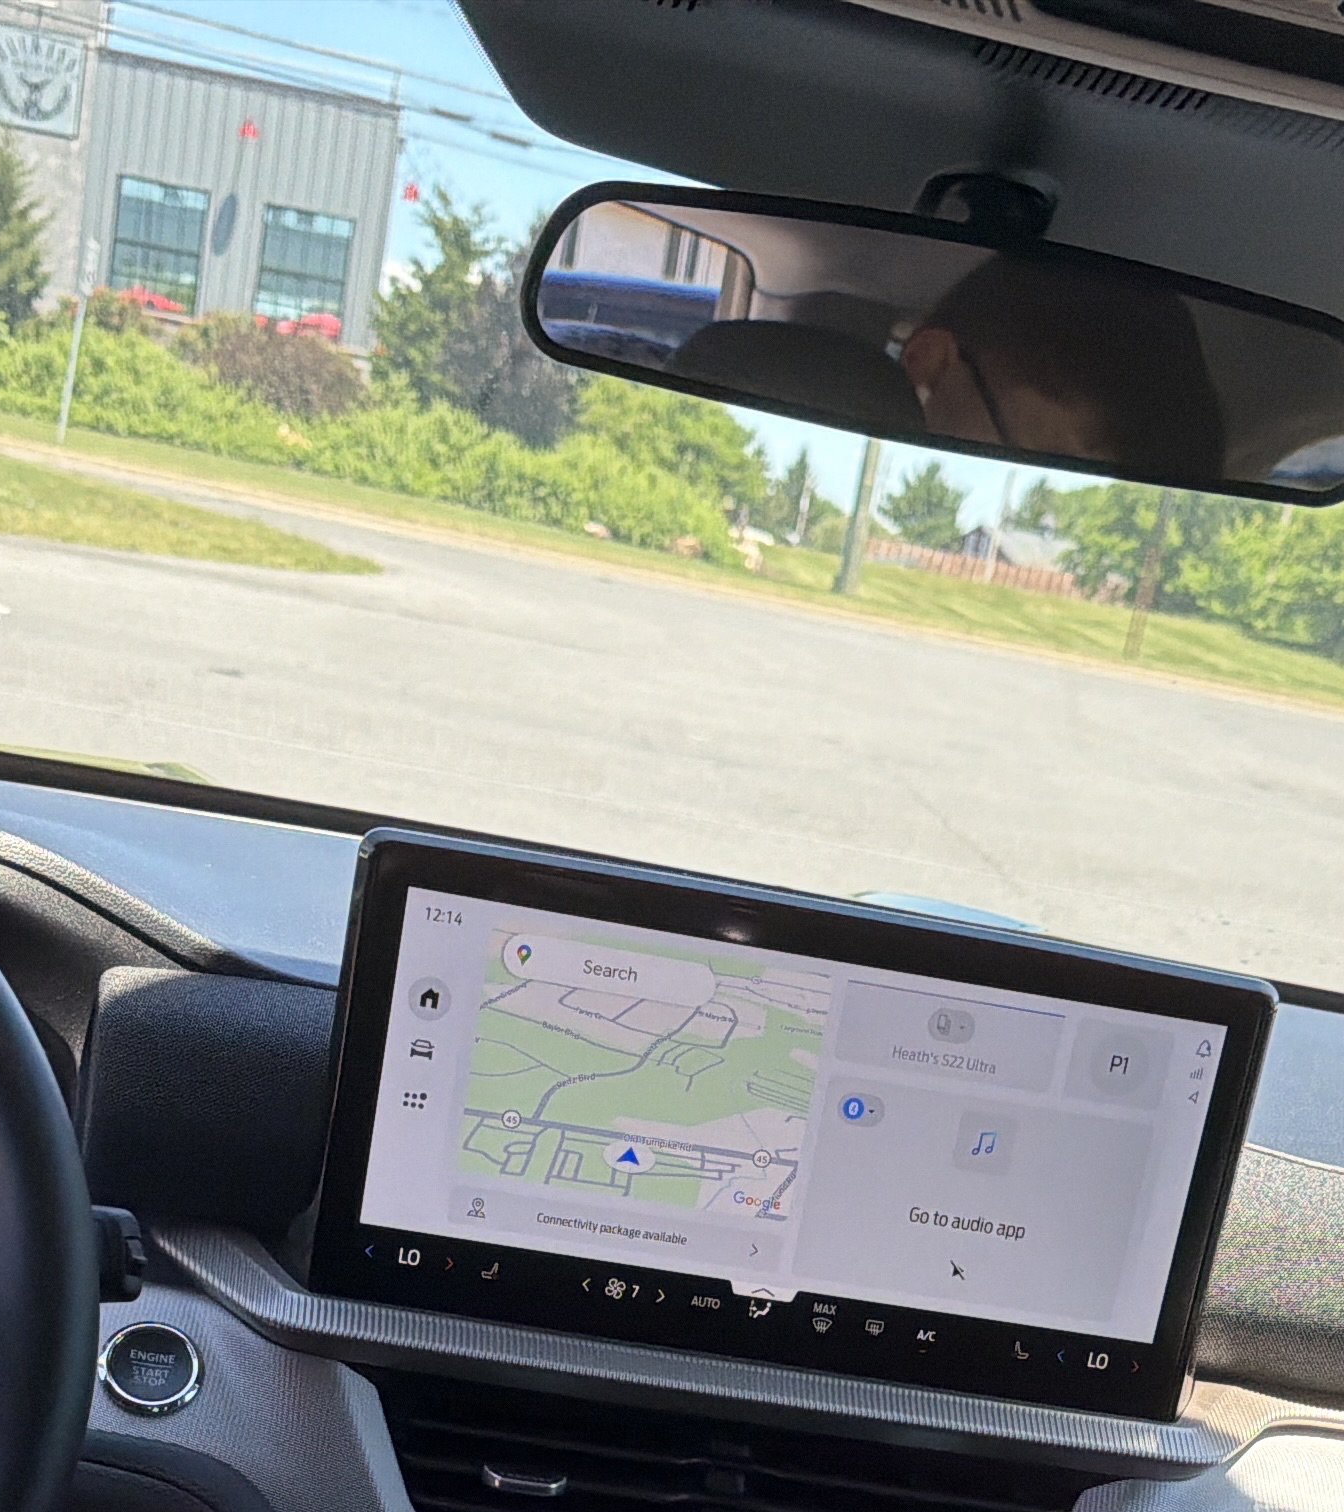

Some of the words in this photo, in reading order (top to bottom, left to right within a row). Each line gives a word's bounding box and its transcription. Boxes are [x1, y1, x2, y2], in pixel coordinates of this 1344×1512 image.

[425, 907, 463, 926] 12:14
[583, 959, 638, 982] Search
[892, 1045, 939, 1065] Heath's
[941, 1053, 964, 1069] S22
[966, 1057, 997, 1075] Ultra
[1109, 1054, 1129, 1075] P1
[506, 1115, 518, 1125] 45
[756, 1155, 768, 1164] 45
[733, 1191, 781, 1211] Google
[536, 1212, 598, 1233] Connectivity
[599, 1224, 641, 1239] package
[642, 1230, 687, 1245] available
[909, 1206, 930, 1225] Go
[934, 1210, 949, 1227] to
[951, 1213, 994, 1234] audio
[996, 1223, 1026, 1241] app
[398, 1247, 421, 1266] LO
[632, 1285, 641, 1298] 7
[690, 1295, 721, 1309] AUTO
[812, 1302, 837, 1316] MAX
[916, 1329, 937, 1342] A/C
[129, 1349, 176, 1364] ENGINE
[1087, 1352, 1109, 1370] LO
[132, 1367, 171, 1378] START
[133, 1375, 166, 1386] STOP
